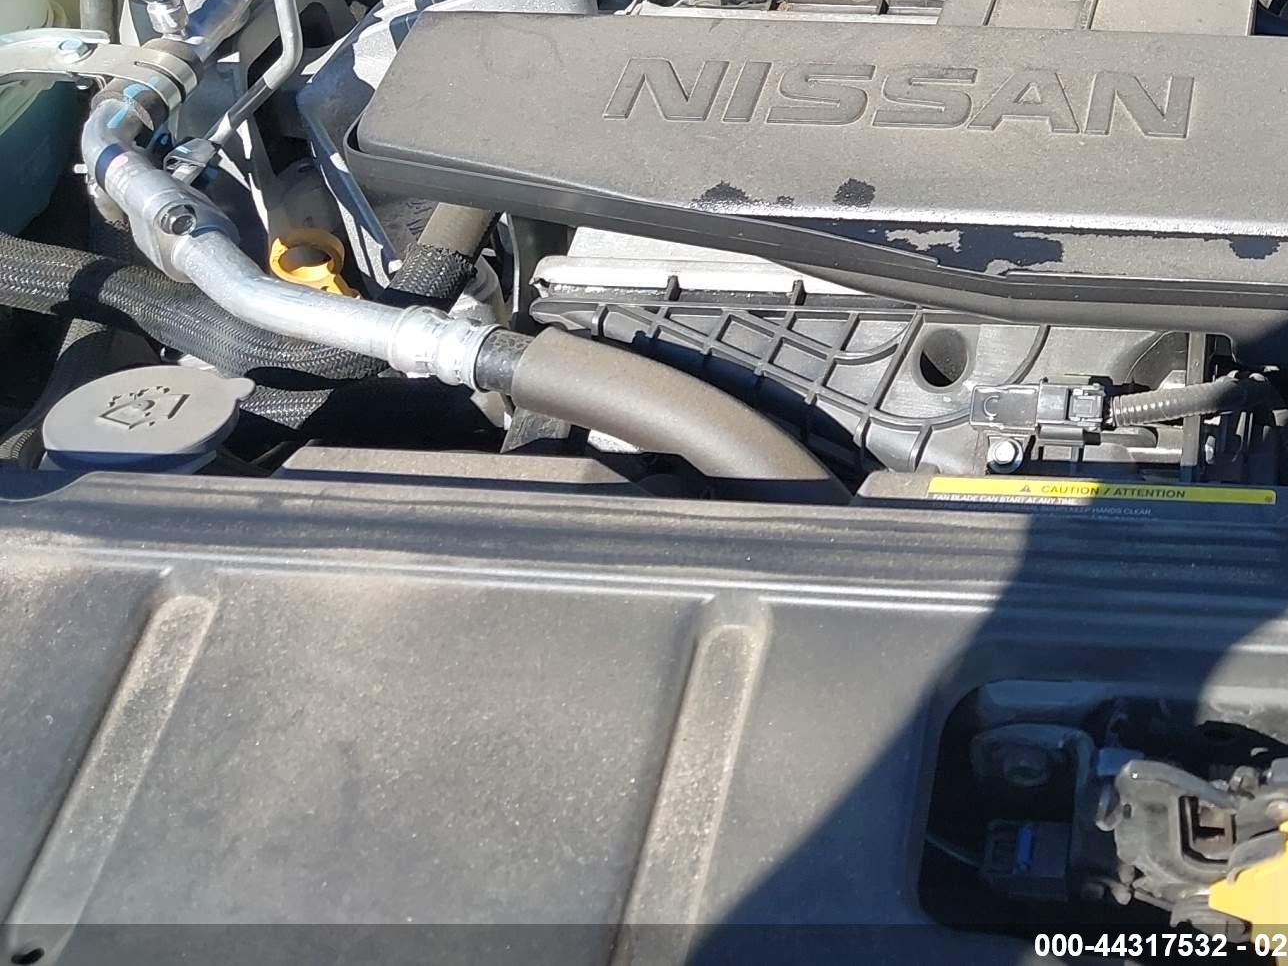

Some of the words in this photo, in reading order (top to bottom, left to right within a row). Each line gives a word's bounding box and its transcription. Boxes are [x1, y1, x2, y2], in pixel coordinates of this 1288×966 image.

[602, 58, 1195, 139] NISSAN
[1040, 484, 1100, 496] CAUTION
[1102, 486, 1111, 496] /
[1112, 487, 1186, 498] ATTENTION
[932, 493, 950, 501] FAN
[950, 494, 979, 502] BLADE
[999, 496, 1026, 504] START
[1038, 497, 1057, 505] ANY
[1091, 507, 1122, 515] HANDS
